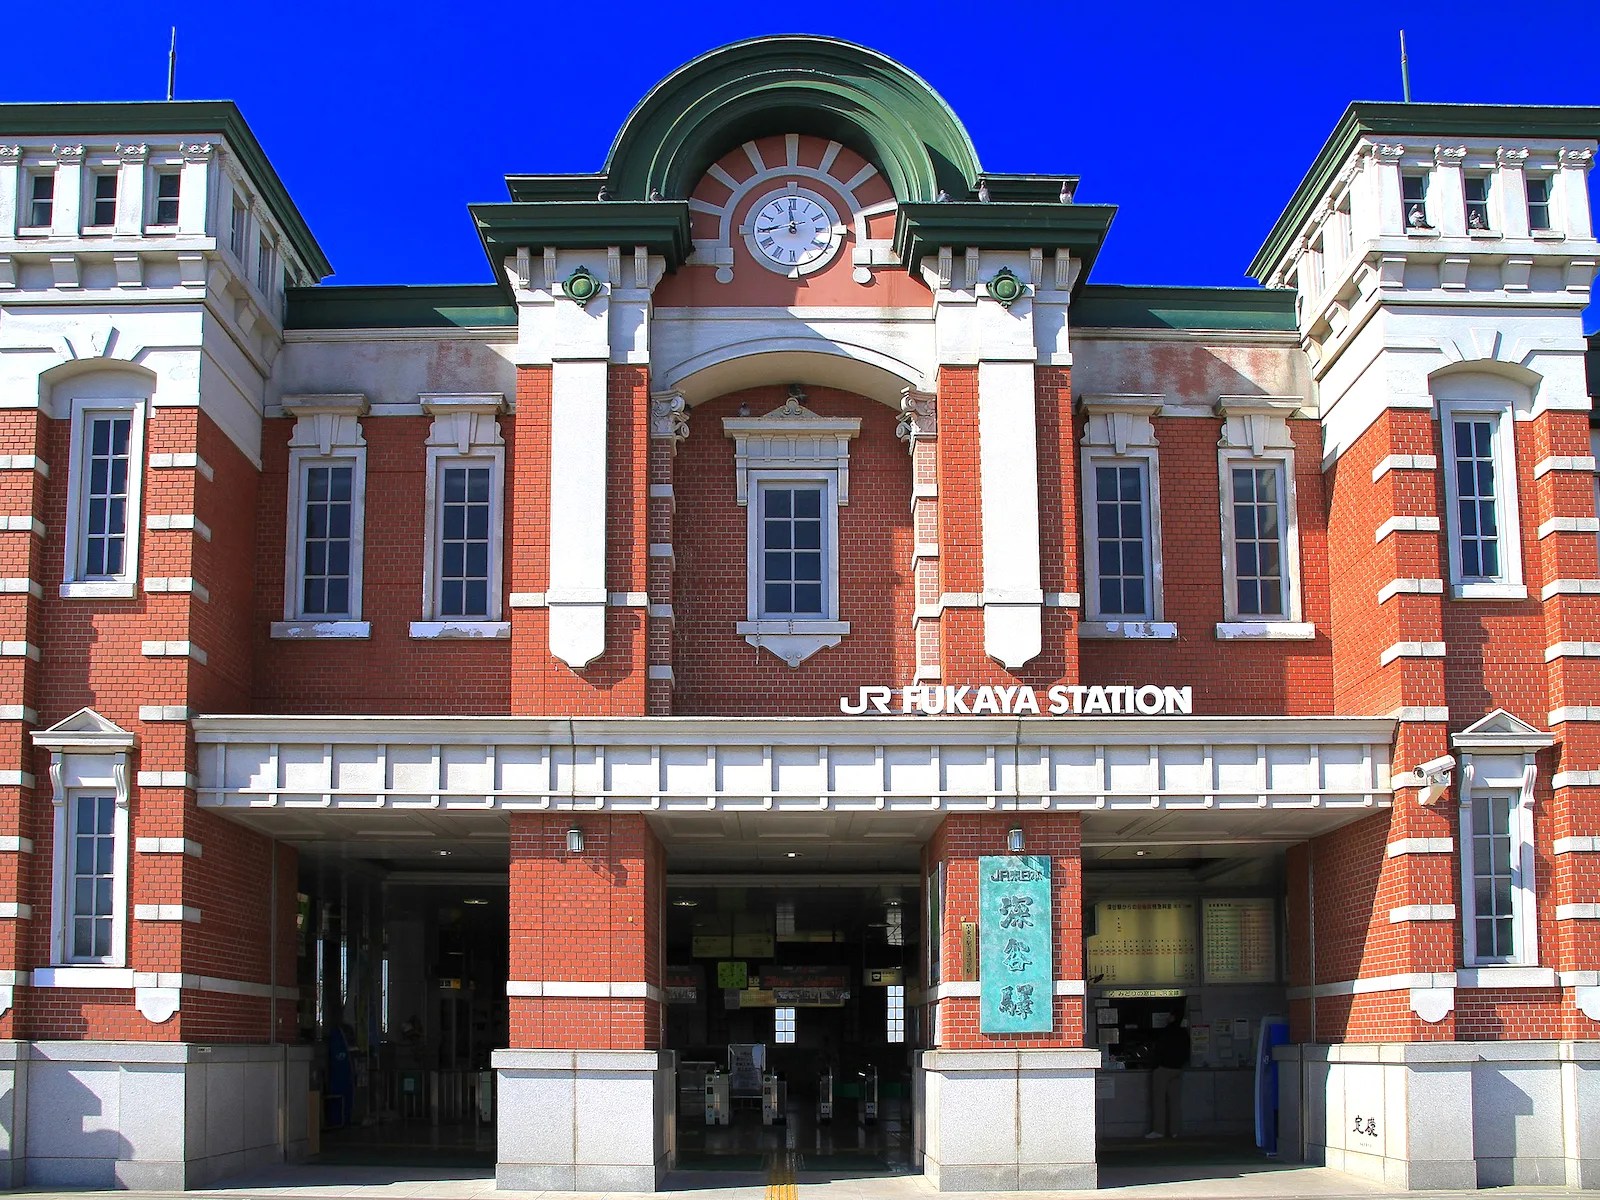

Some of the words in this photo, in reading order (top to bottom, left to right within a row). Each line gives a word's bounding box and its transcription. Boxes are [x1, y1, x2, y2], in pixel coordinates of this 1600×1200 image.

[803, 202, 811, 213] I
[811, 212, 824, 222] II
[839, 685, 893, 715] JR
[902, 684, 1041, 715] FUKAYA
[1048, 684, 1193, 716] STATION
[990, 869, 1043, 882] JR東日本
